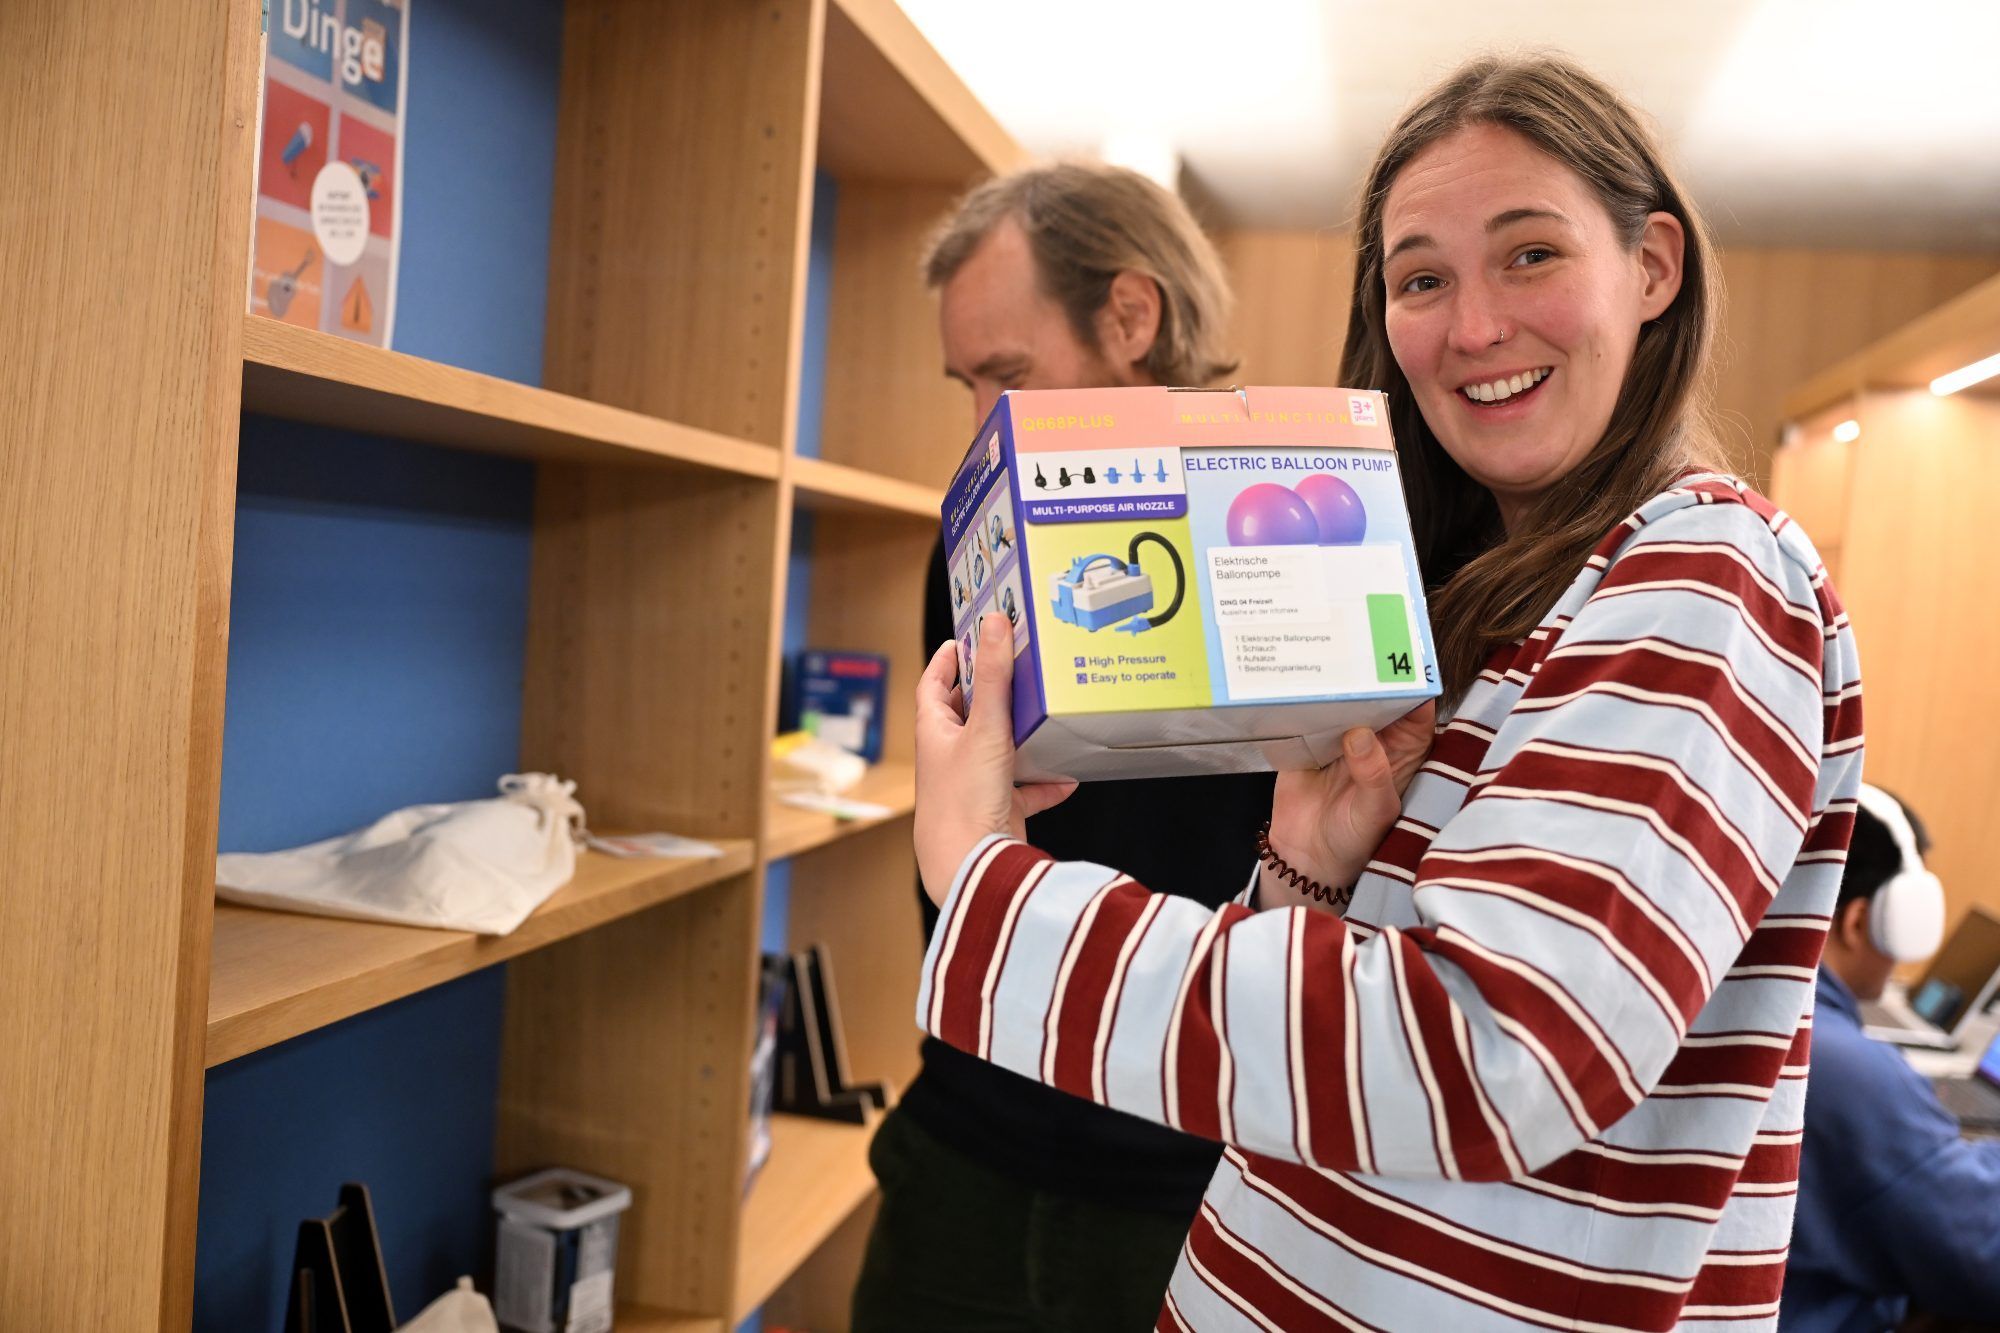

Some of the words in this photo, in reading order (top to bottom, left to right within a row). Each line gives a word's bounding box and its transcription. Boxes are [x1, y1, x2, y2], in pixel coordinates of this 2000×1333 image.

[283, 0, 384, 86] Dinge
[1352, 400, 1371, 414] 3+
[1021, 414, 1116, 431] Q668PLUS
[1185, 457, 1267, 471] ELECTRIC
[1272, 457, 1348, 471] BALLOON
[1352, 458, 1392, 472] PUMP
[1032, 503, 1115, 516] MULTI-PURPOSE
[1117, 502, 1135, 512] AIR
[1136, 501, 1175, 511] NOZZLE
[1214, 556, 1268, 567] Elektrische
[1216, 569, 1281, 580] Ballonpumpe
[1241, 634, 1281, 643] Elektrische
[1283, 634, 1331, 643] Ballonpumpe
[1242, 644, 1276, 652] Schlauch
[1089, 656, 1115, 668] High
[1118, 655, 1167, 664] Pressure
[1243, 654, 1276, 662] Aufsätze
[1387, 652, 1412, 675] 14
[1244, 664, 1321, 673] Bedienungsanleitung
[1091, 673, 1117, 684] Easy
[1121, 672, 1132, 681] to
[1136, 671, 1176, 682] operate
